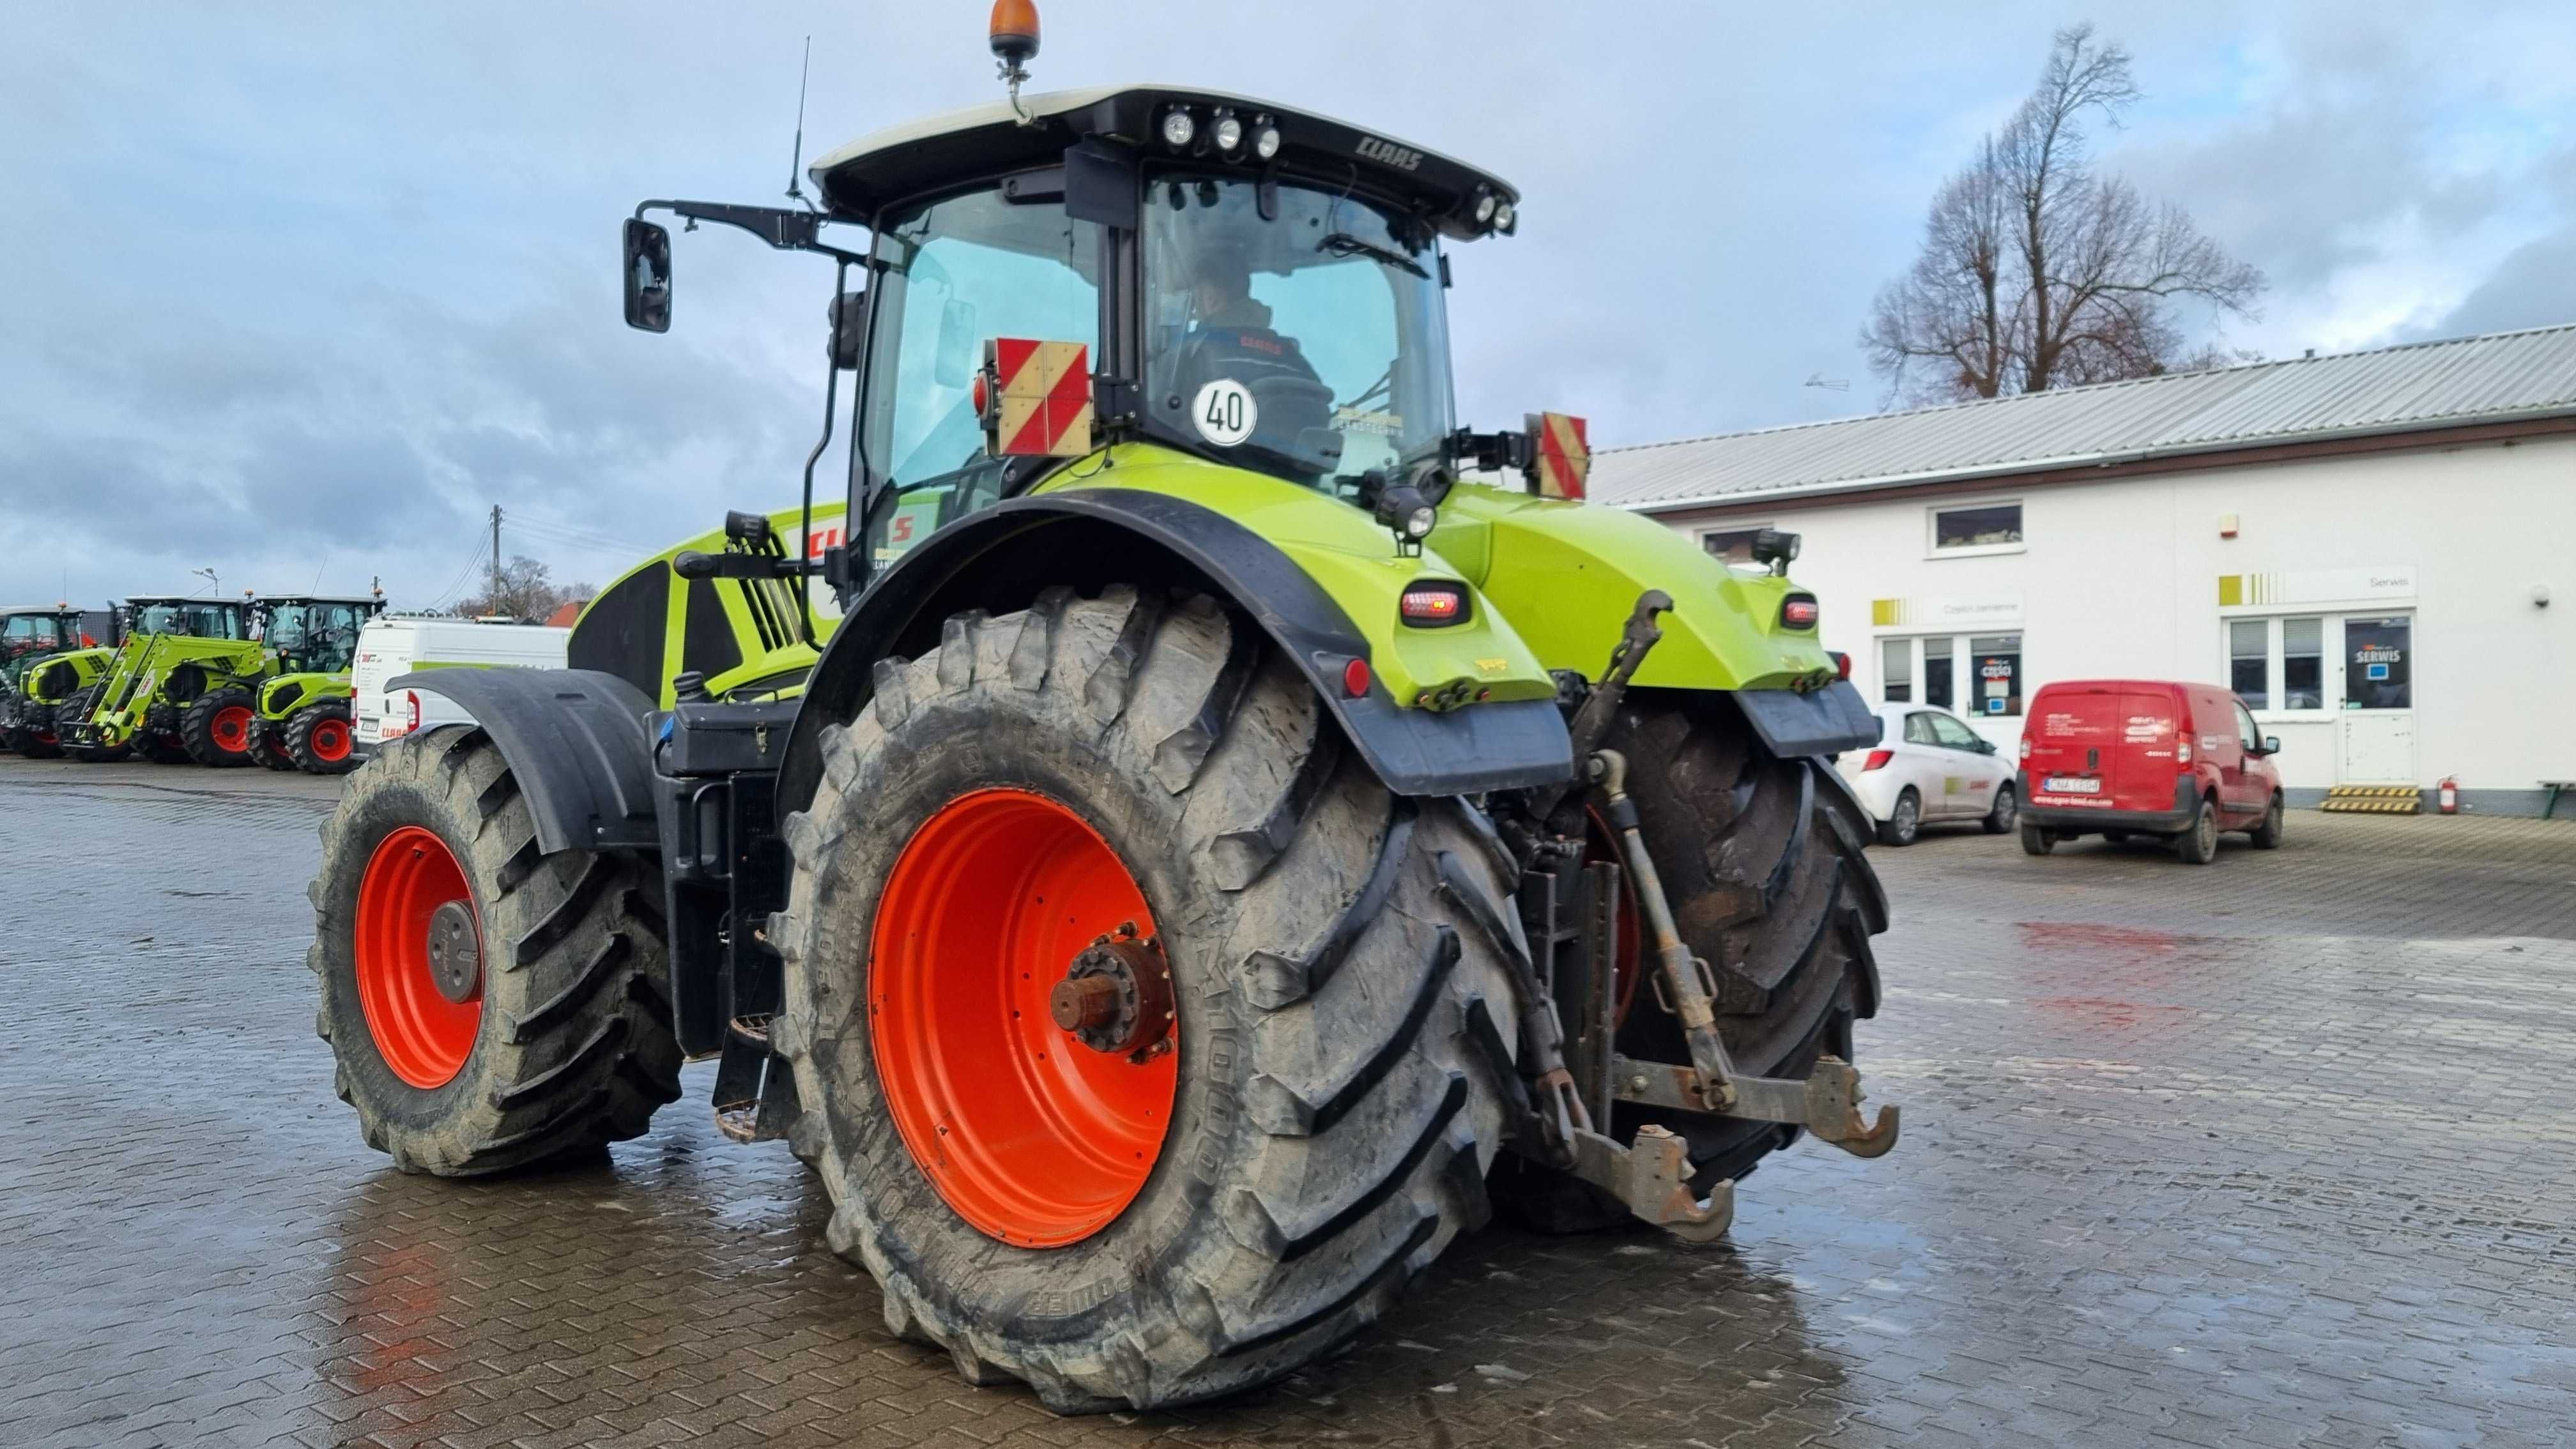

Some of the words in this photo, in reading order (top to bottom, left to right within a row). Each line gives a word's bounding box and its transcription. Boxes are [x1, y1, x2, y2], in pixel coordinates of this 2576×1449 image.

[1355, 136, 1423, 171] CLAAS
[1206, 390, 1241, 432] 40
[2369, 577, 2409, 588] Serwis
[2355, 649, 2401, 664] SERWIS
